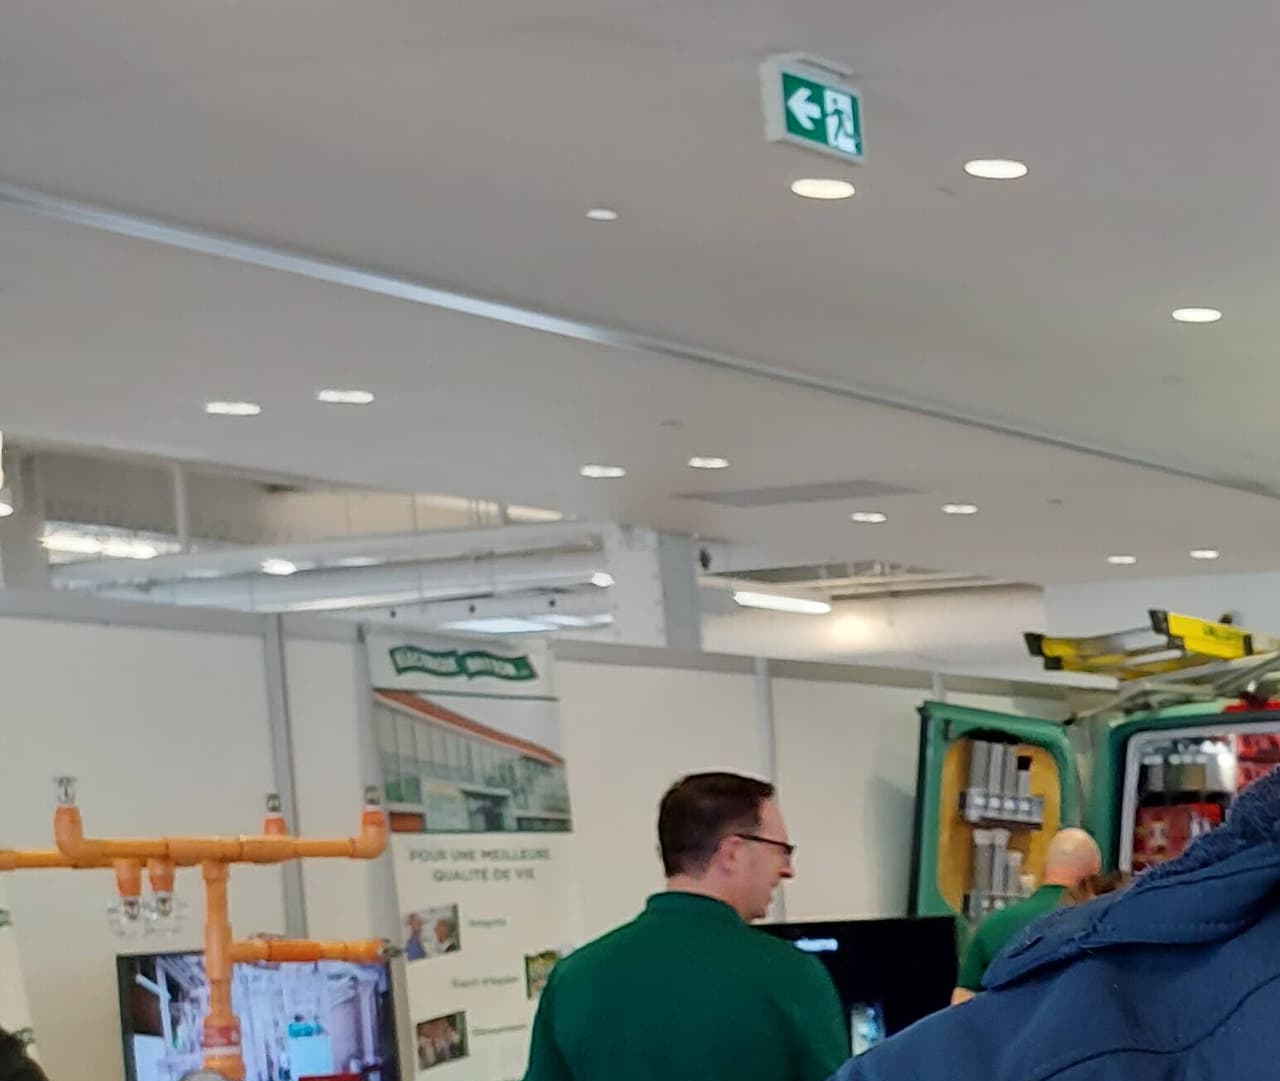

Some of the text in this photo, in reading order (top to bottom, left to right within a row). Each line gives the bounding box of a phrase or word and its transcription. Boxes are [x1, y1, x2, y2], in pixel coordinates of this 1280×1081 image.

[409, 848, 550, 861] POUR UNE MEILLEURE
[433, 867, 535, 882] QUALITÉ DE VIE
